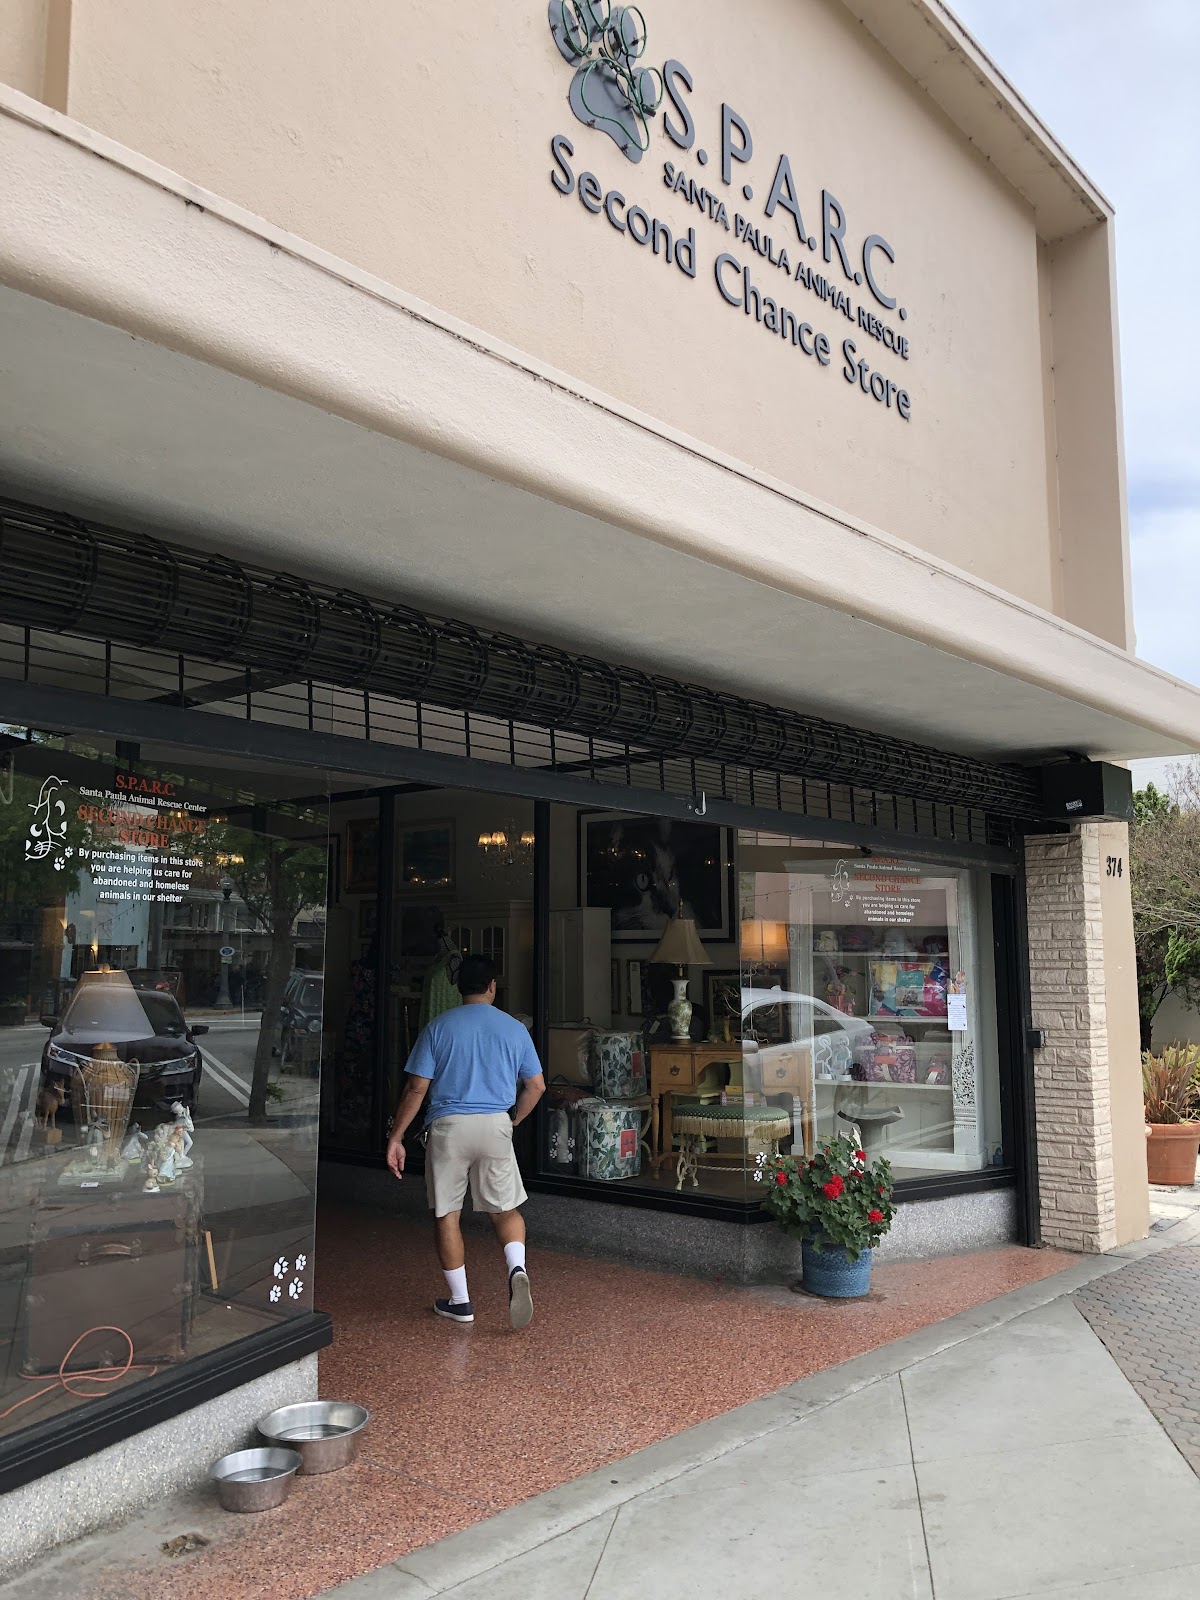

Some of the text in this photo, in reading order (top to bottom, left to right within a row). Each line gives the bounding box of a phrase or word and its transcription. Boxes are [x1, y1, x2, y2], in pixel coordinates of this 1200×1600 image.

[662, 58, 909, 321] S.P.A.R.C.
[663, 160, 910, 361] SANTA PAULA ANIMAL RESCUE
[550, 133, 912, 421] Second Chance Store
[115, 774, 176, 796] S.P.A.R.C.
[79, 786, 207, 812] Santa Paula Animal Rescue Center
[77, 804, 206, 834] SECOND CHANCE
[119, 829, 170, 849] STORE
[79, 848, 203, 868] By purchasing items in this store
[1106, 855, 1123, 878] 374
[91, 863, 193, 879] you are helping us care for
[854, 873, 887, 882] SECOND
[93, 876, 190, 891] abandoned and homeless
[875, 884, 901, 893] STORE
[100, 890, 183, 903] animals in our shelter
